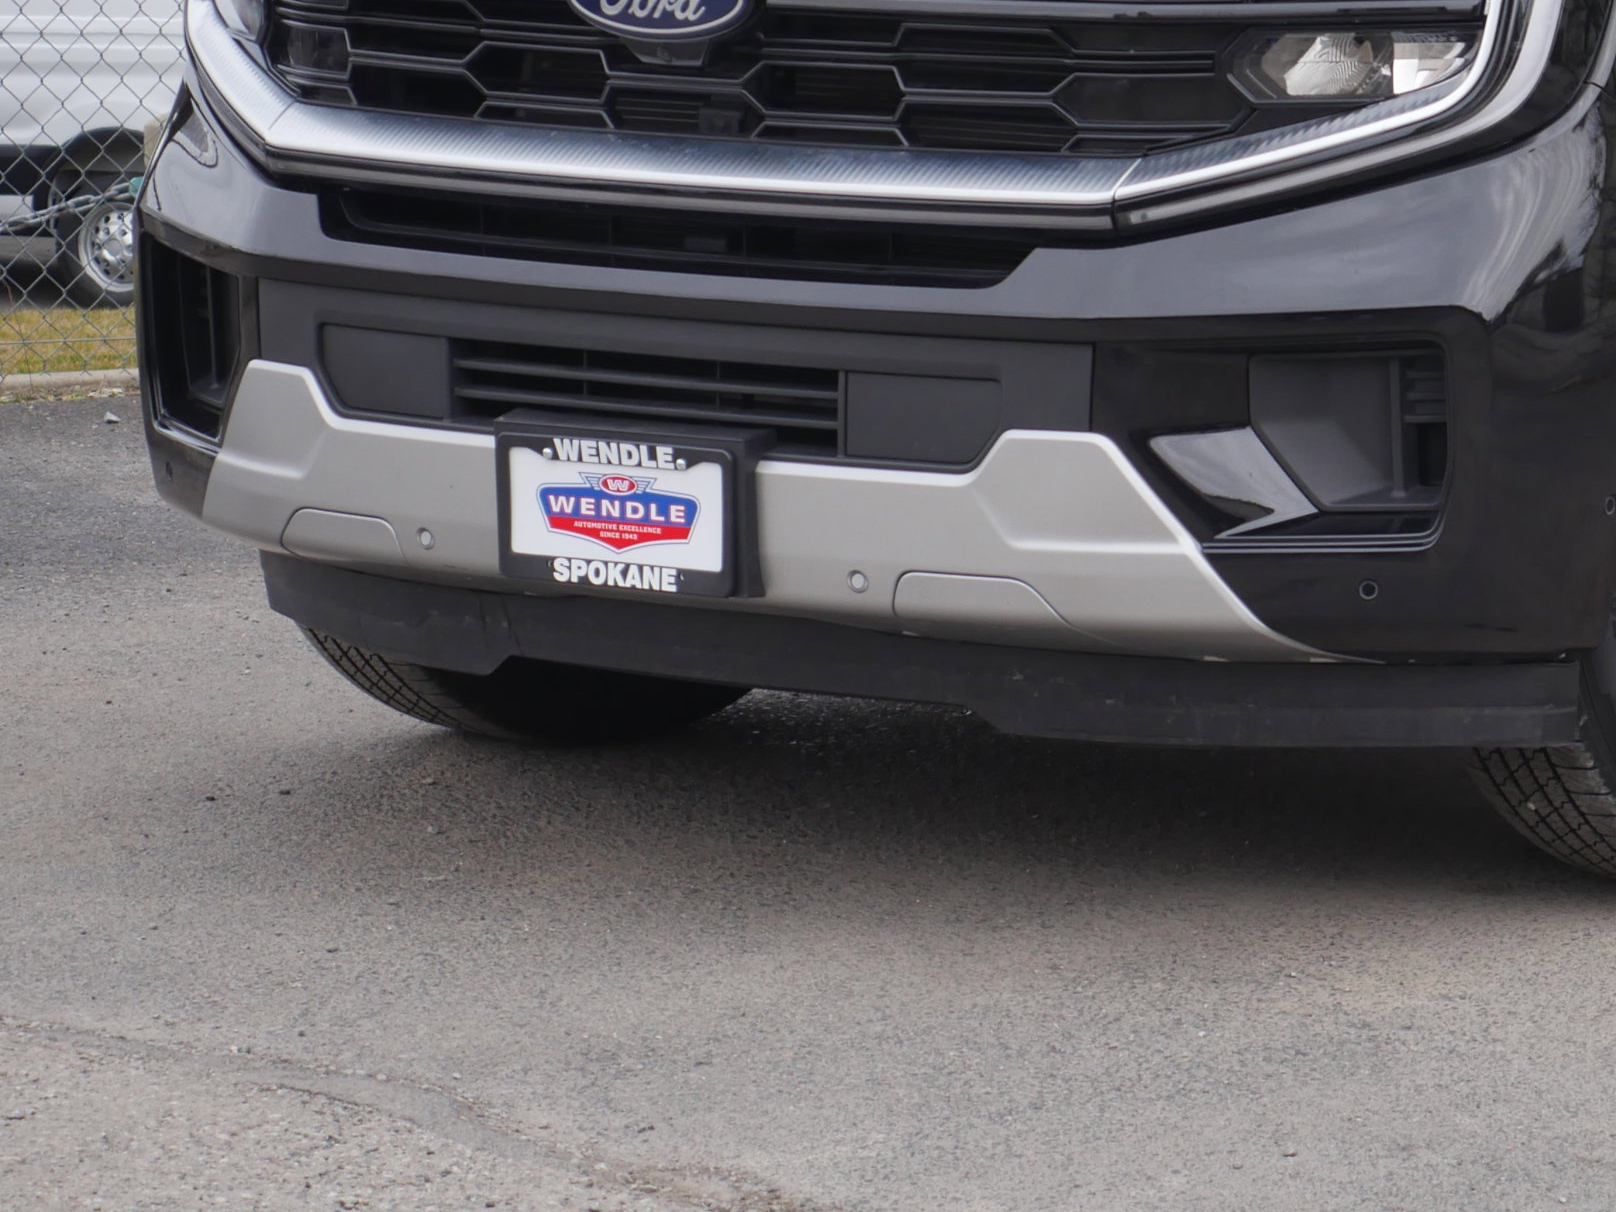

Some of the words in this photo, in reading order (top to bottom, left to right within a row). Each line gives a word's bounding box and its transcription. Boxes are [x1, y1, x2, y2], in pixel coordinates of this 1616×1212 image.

[553, 438, 676, 470] WENDLE
[548, 494, 686, 523] WENDLE
[573, 521, 617, 531] AUTOMOTIVE
[619, 524, 662, 534] EXCELLENCE
[599, 531, 620, 539] SINCE
[553, 557, 677, 592] SPOKANE
